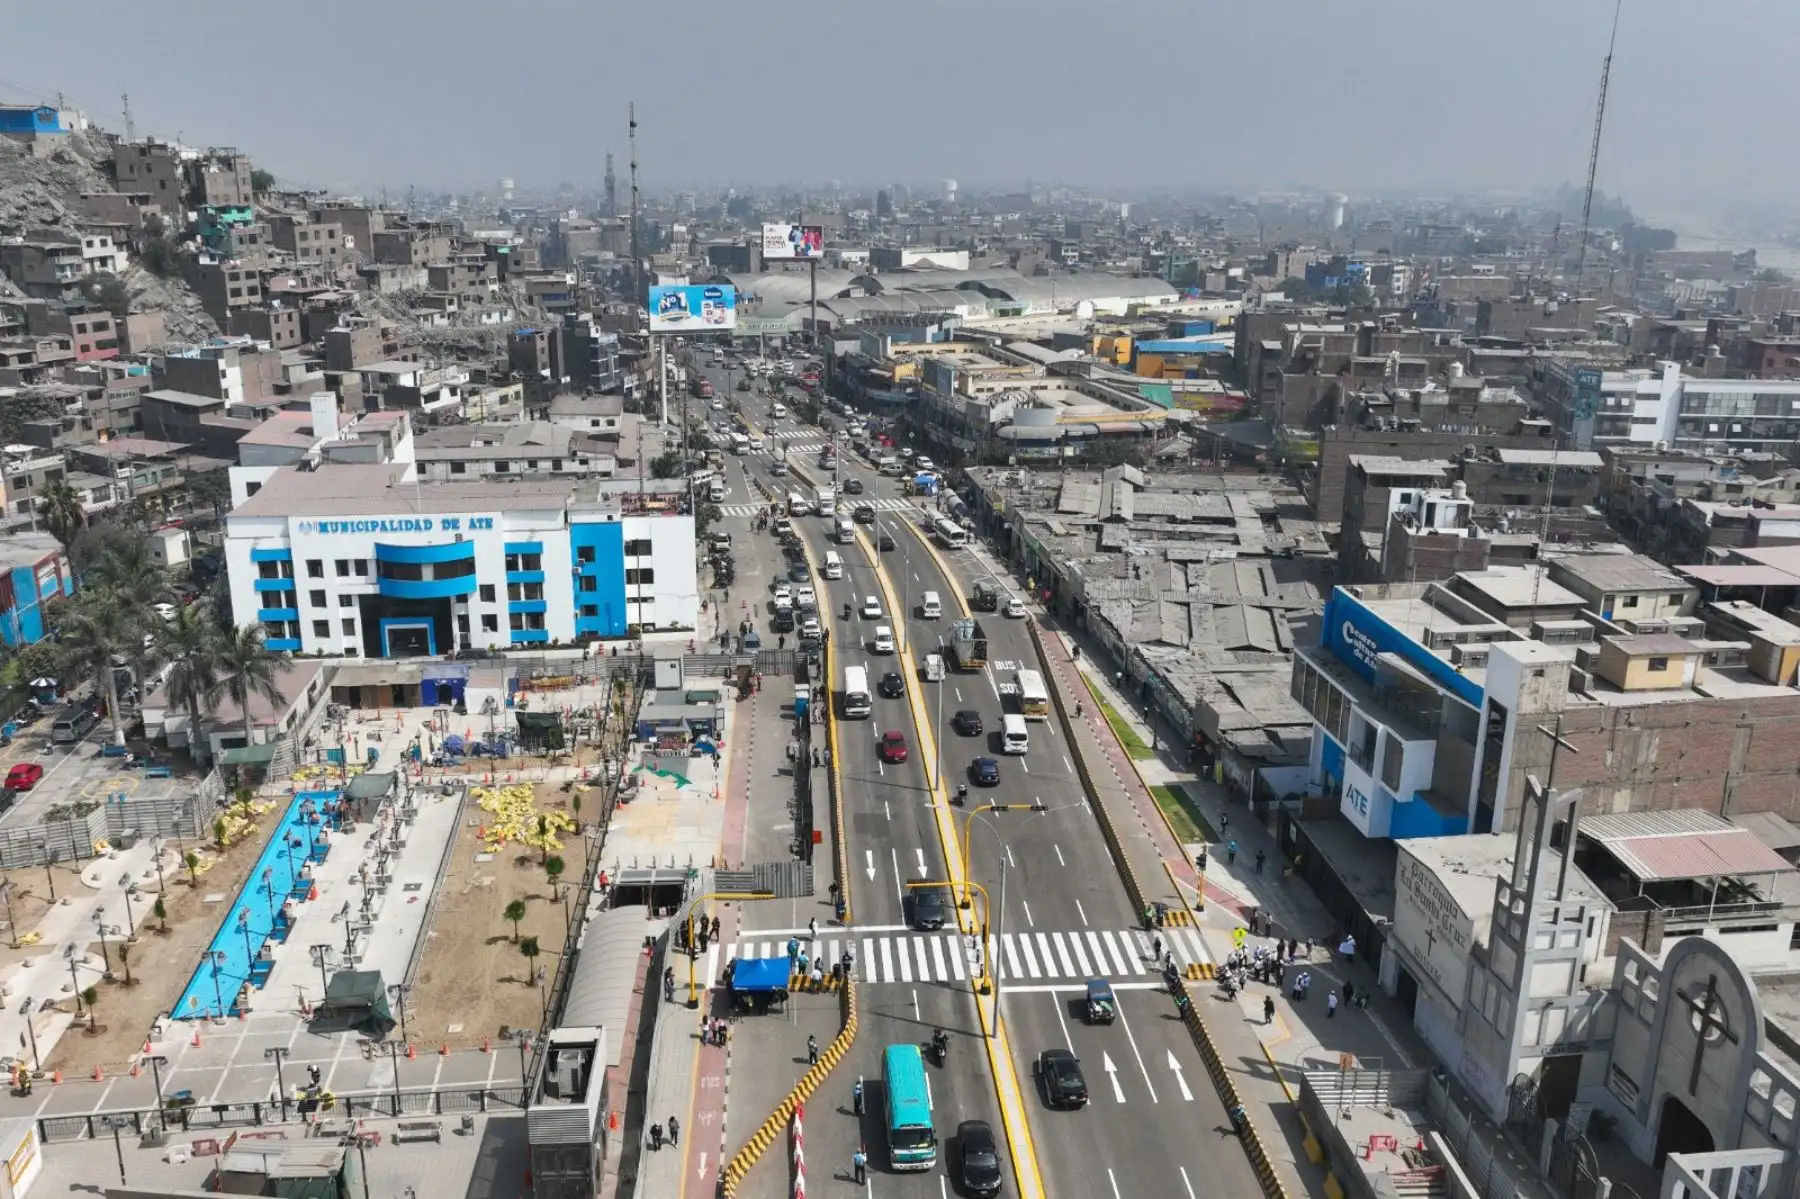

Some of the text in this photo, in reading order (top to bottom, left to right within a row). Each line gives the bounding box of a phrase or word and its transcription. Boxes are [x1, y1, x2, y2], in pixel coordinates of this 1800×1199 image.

[318, 517, 493, 534] MUNICIPALIDAD DE ATE
[994, 660, 1017, 670] BUS
[1345, 783, 1368, 816] ATE
